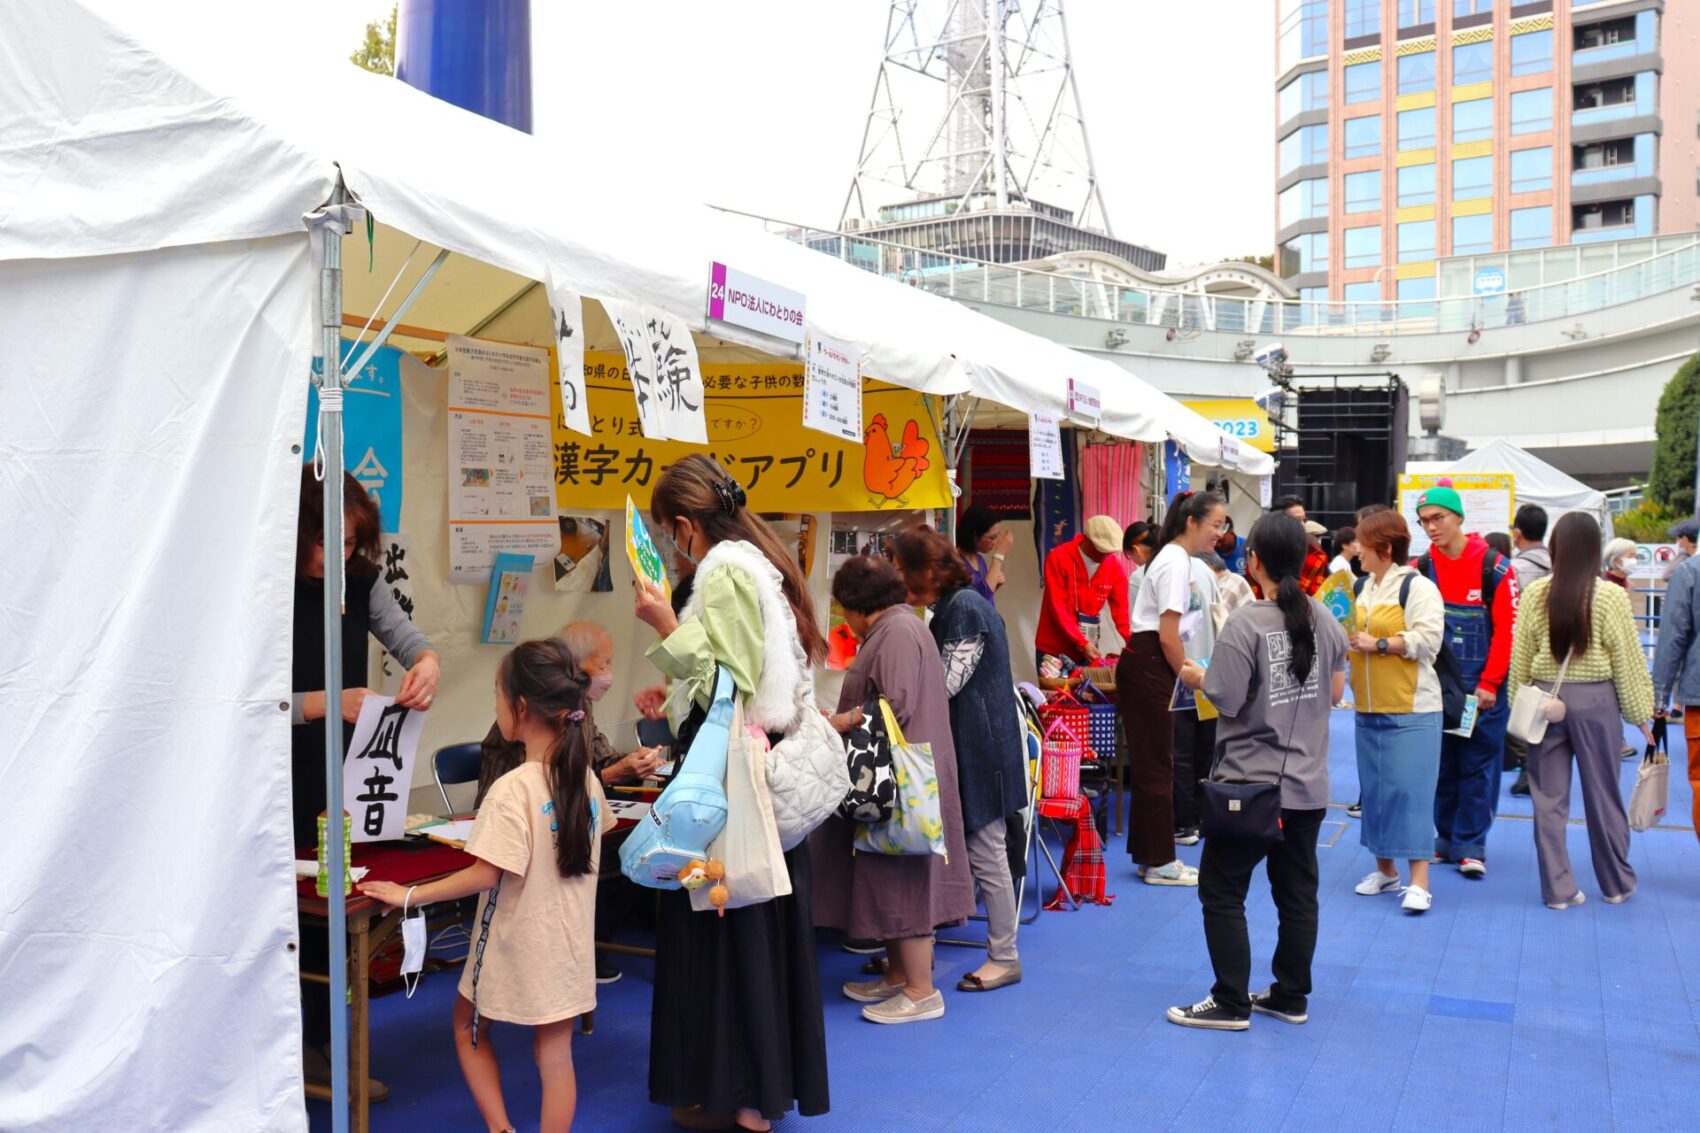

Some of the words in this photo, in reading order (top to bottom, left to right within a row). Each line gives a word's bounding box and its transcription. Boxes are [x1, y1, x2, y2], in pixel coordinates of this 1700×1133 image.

[712, 283, 724, 300] 24
[728, 288, 804, 326] NPO法人にわとりの会
[704, 374, 806, 390] 必要な子供の数
[1214, 421, 1257, 436] 023
